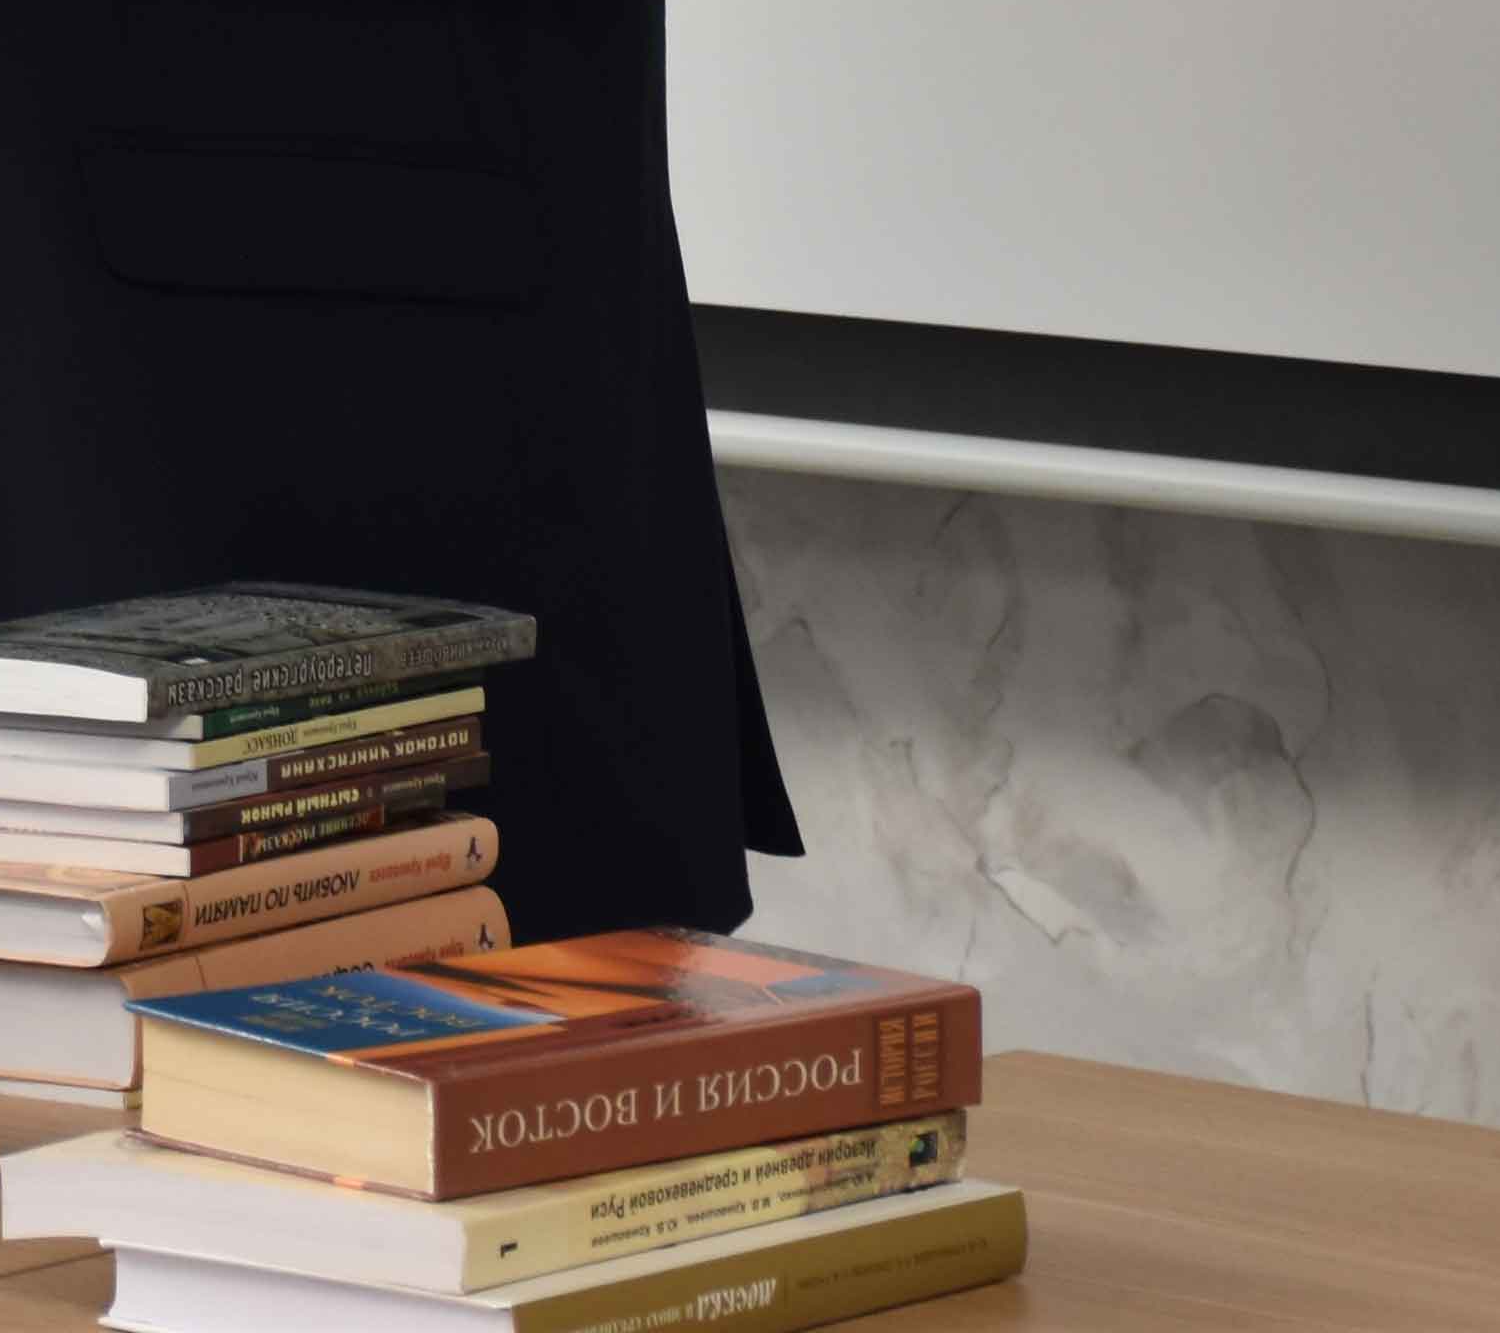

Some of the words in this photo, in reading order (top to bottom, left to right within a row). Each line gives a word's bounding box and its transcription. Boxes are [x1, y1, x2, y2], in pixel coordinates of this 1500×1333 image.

[166, 667, 244, 706] рассказы
[250, 651, 373, 690] Петербургские
[243, 726, 297, 754] ДОНБАСС
[393, 729, 470, 757] ПОТОМОК
[279, 744, 391, 779] ЧИНГИСХАНА
[239, 800, 293, 826] РЫНОК
[293, 787, 360, 817] СЫТНЫЙ
[264, 884, 290, 910] ПО
[292, 868, 361, 903] ЛЮБИТЬ
[194, 892, 261, 927] ПАМЯТИ
[696, 1047, 863, 1114] РОССИЯ
[654, 1078, 684, 1120] И
[467, 1090, 639, 1155] ВОСТОК
[741, 1168, 752, 1180] и
[754, 1150, 814, 1182] древней
[590, 1194, 625, 1220] Руси
[628, 1169, 739, 1210] средневековой
